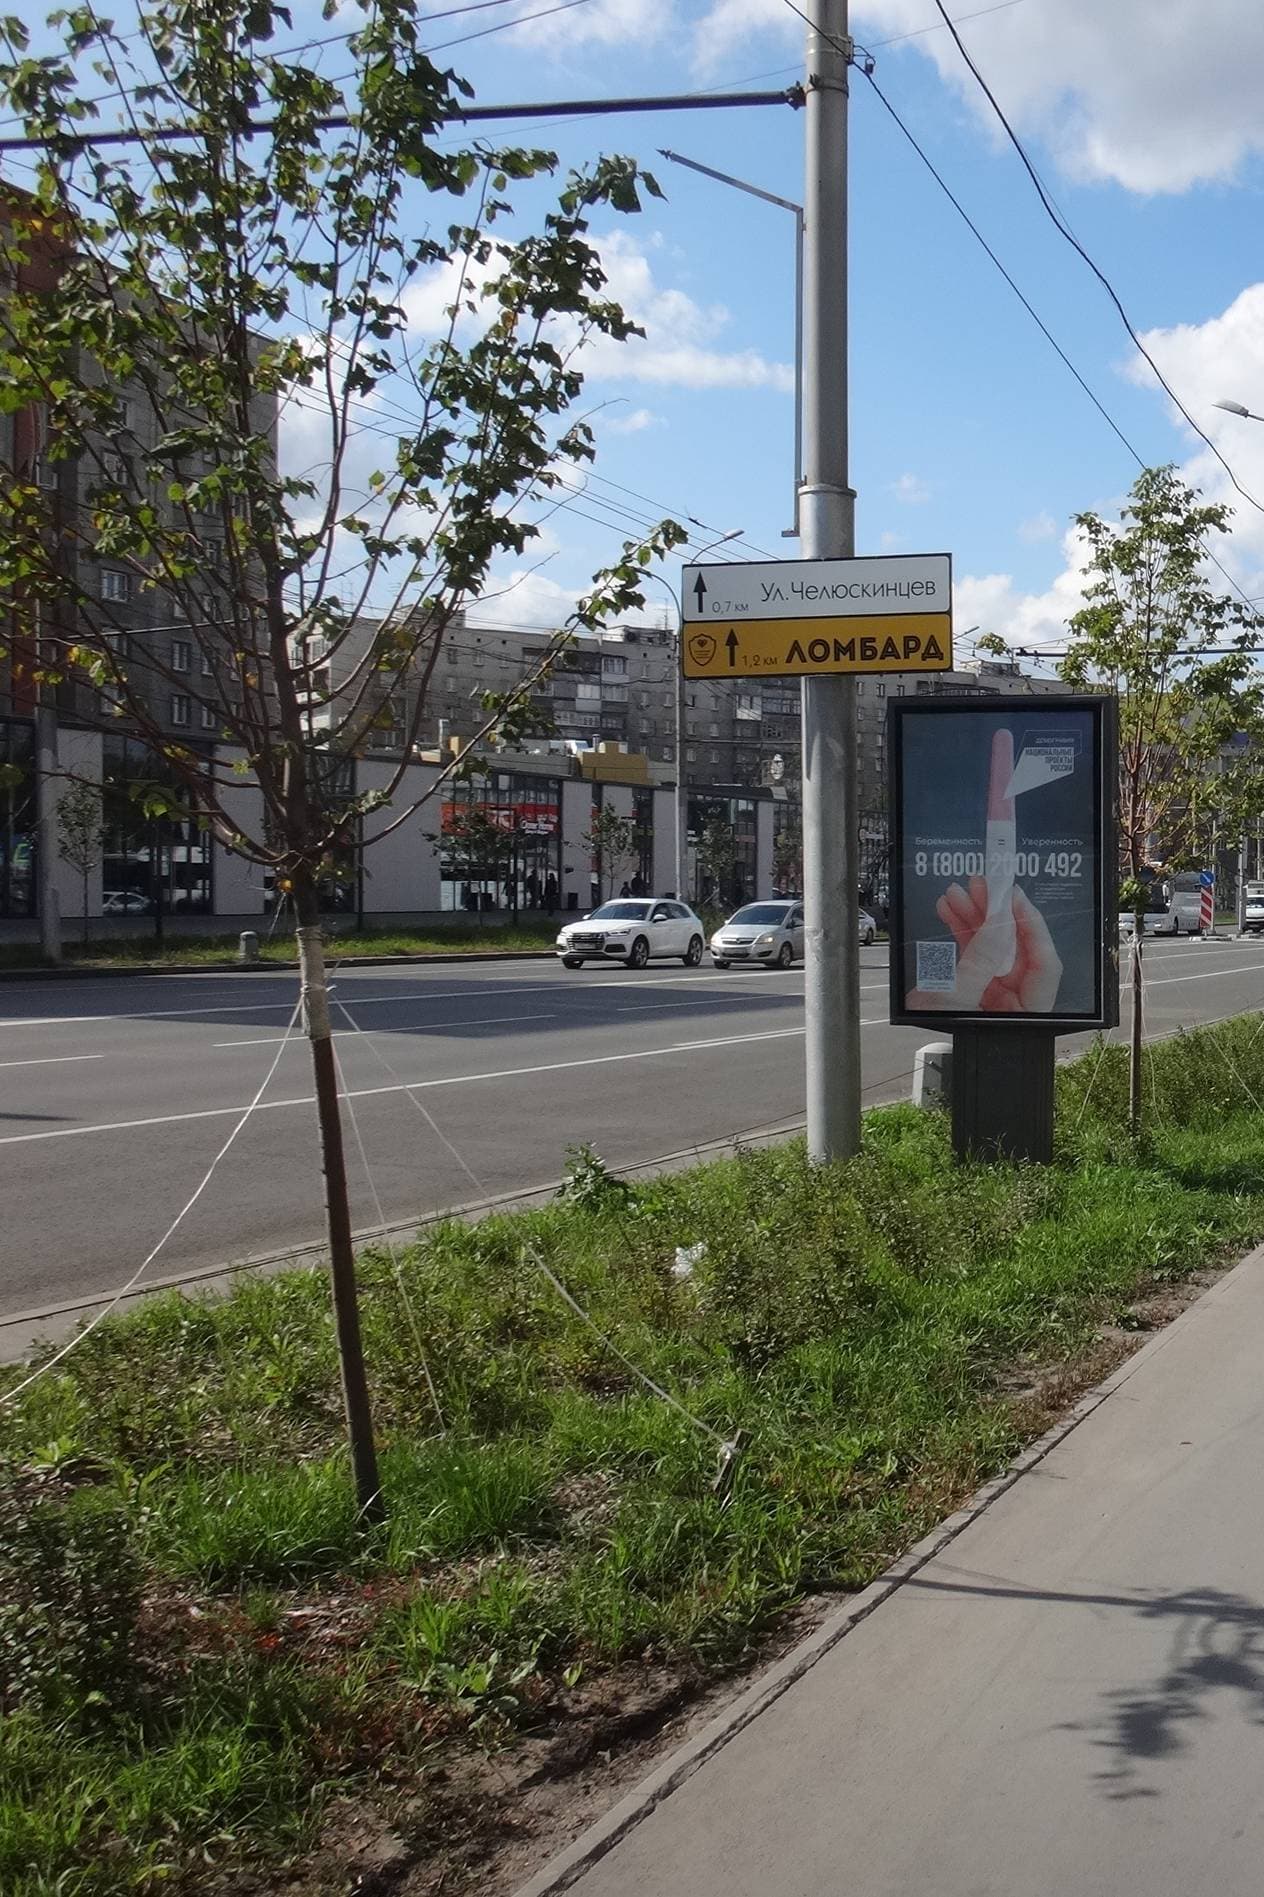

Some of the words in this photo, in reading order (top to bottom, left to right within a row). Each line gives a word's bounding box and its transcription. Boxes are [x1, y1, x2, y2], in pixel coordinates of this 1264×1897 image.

[761, 582, 789, 602] Ул.
[790, 580, 937, 601] Челюскинцев
[711, 601, 732, 614] 0,7
[734, 602, 750, 612] км
[785, 634, 945, 665] ЛОМБАРД
[742, 655, 762, 668] 1,2
[763, 657, 778, 667] км
[915, 837, 983, 847] Беременность
[1022, 837, 1084, 847] Уверенность
[915, 852, 928, 877] 8
[933, 852, 984, 876] (800)
[990, 852, 1040, 878] 2000
[1044, 852, 1082, 878] 492
